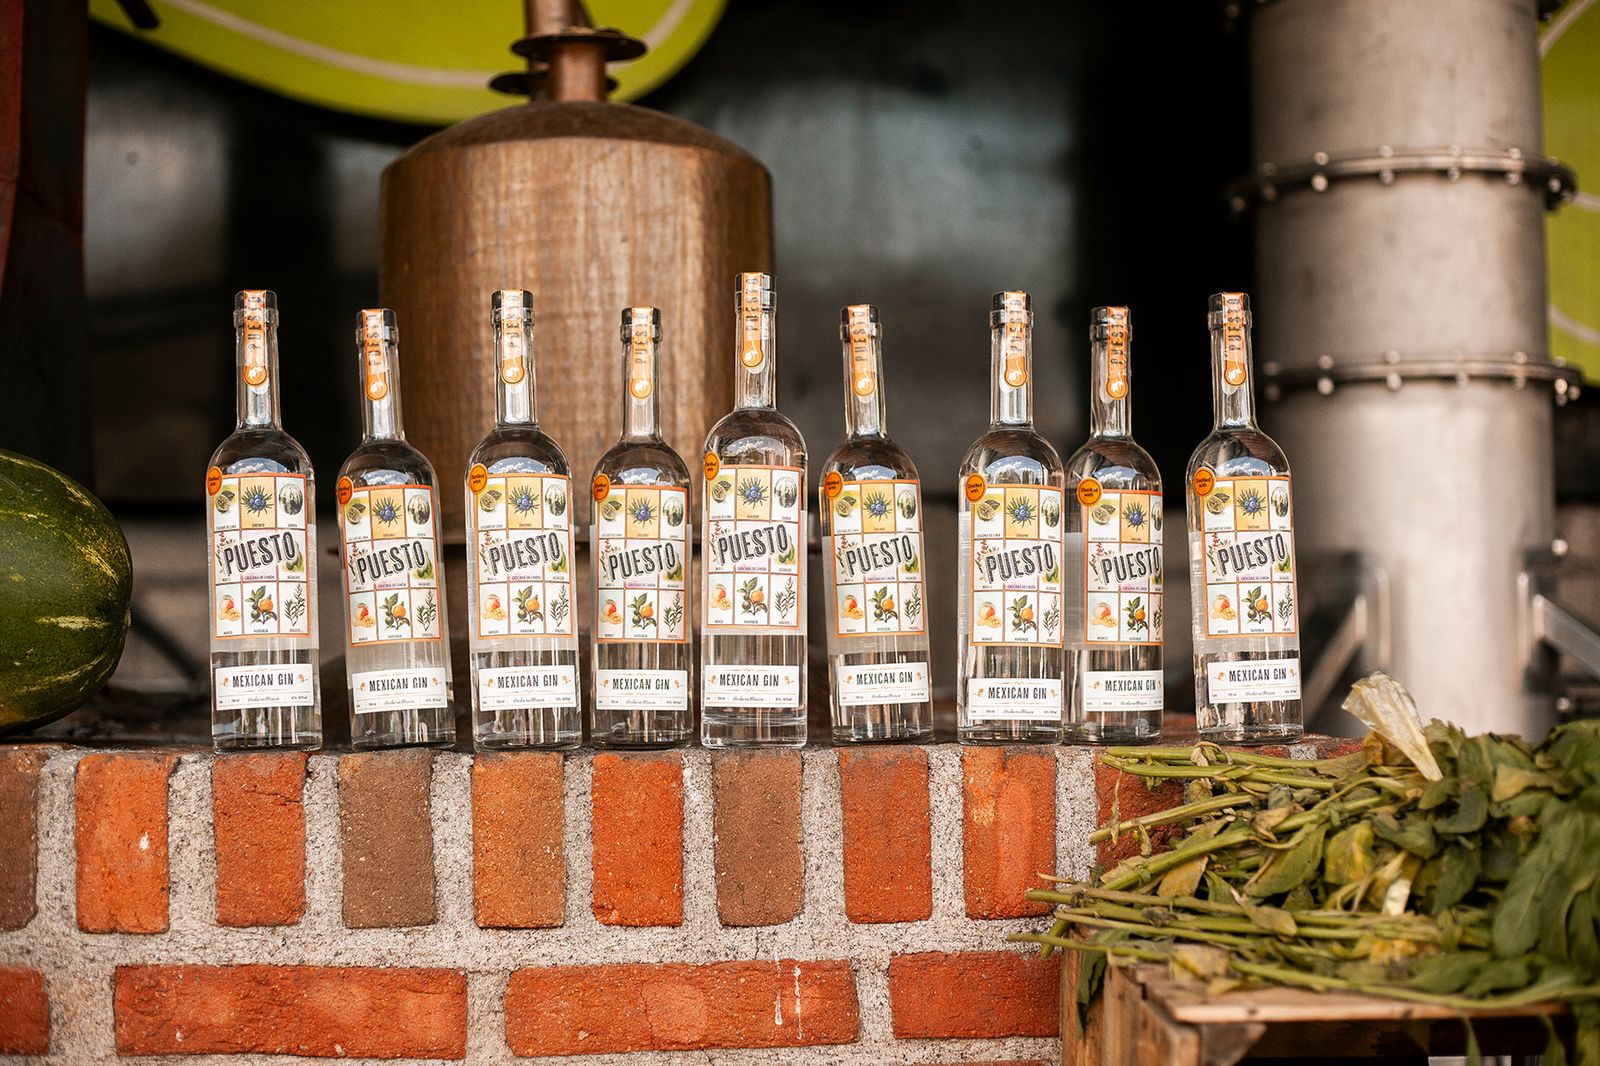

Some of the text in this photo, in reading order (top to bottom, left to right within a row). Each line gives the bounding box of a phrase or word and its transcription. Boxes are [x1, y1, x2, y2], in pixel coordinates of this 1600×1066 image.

[745, 277, 759, 331] PUESTO
[853, 310, 867, 362] PUESTO
[223, 531, 296, 576] PUESTO
[356, 540, 425, 585] PUESTO
[489, 532, 560, 577] PUESTO
[608, 542, 677, 582] PUESTO
[718, 524, 788, 566] PUESTO
[845, 534, 913, 577] PUESTO
[984, 543, 1054, 585] PUESTO
[1217, 533, 1286, 577] PUESTO
[1101, 546, 1160, 586] PUESTO
[232, 672, 294, 688] MEXICAN GIN
[369, 676, 428, 692] MEXICAN GIN
[497, 674, 558, 689] MEXICAN GIN
[612, 678, 670, 690] MEXICAN GIN
[719, 674, 779, 687] MEXICAN GIN
[856, 671, 913, 685] MEXICAN GIN
[988, 687, 1047, 699] MEXICAN GIN
[1105, 679, 1157, 692] MEXICAN GIN
[1229, 667, 1287, 682] MEXICAN GIN
